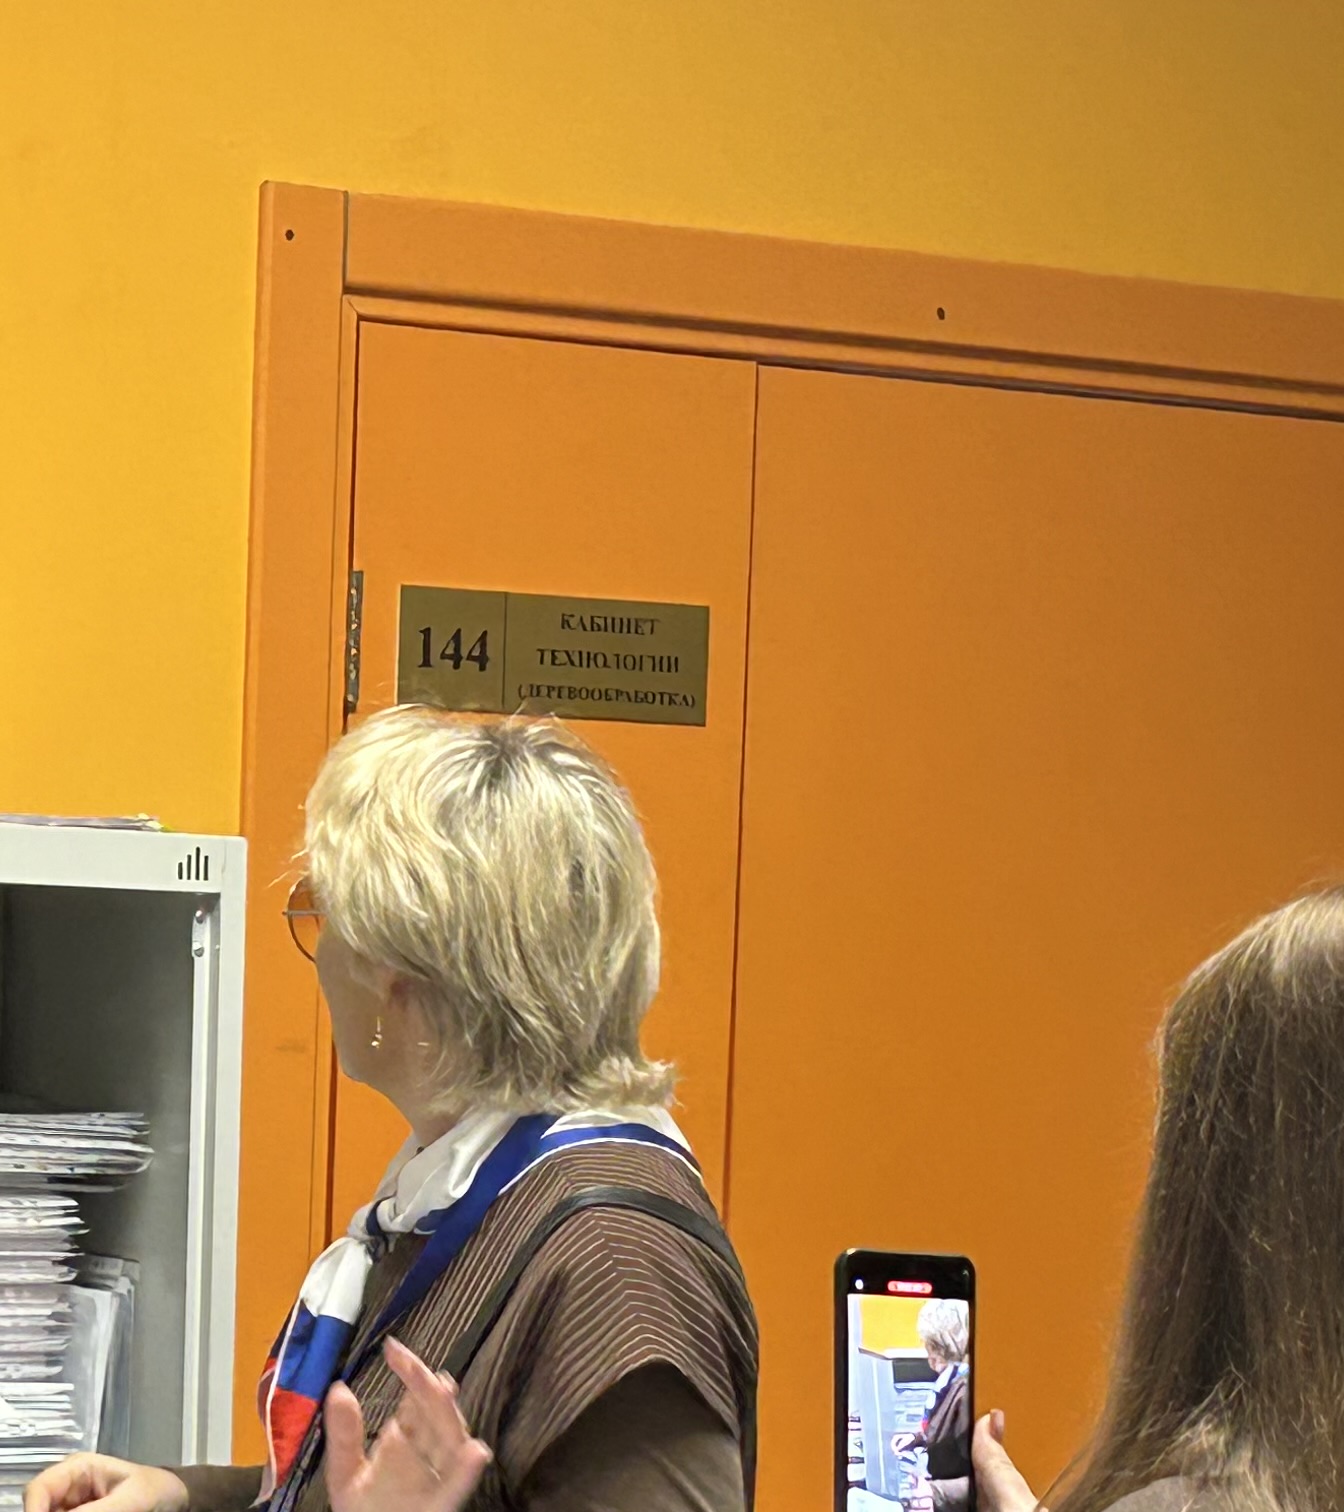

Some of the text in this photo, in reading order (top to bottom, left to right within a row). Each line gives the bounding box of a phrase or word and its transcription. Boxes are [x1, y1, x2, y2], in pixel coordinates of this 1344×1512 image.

[560, 612, 659, 636] КАБИНЕТ
[417, 626, 490, 673] 144
[536, 647, 680, 674] ТЕХНОЛОГИИ
[517, 683, 696, 709] (ДЕРЕВООБРАБОТКА)
